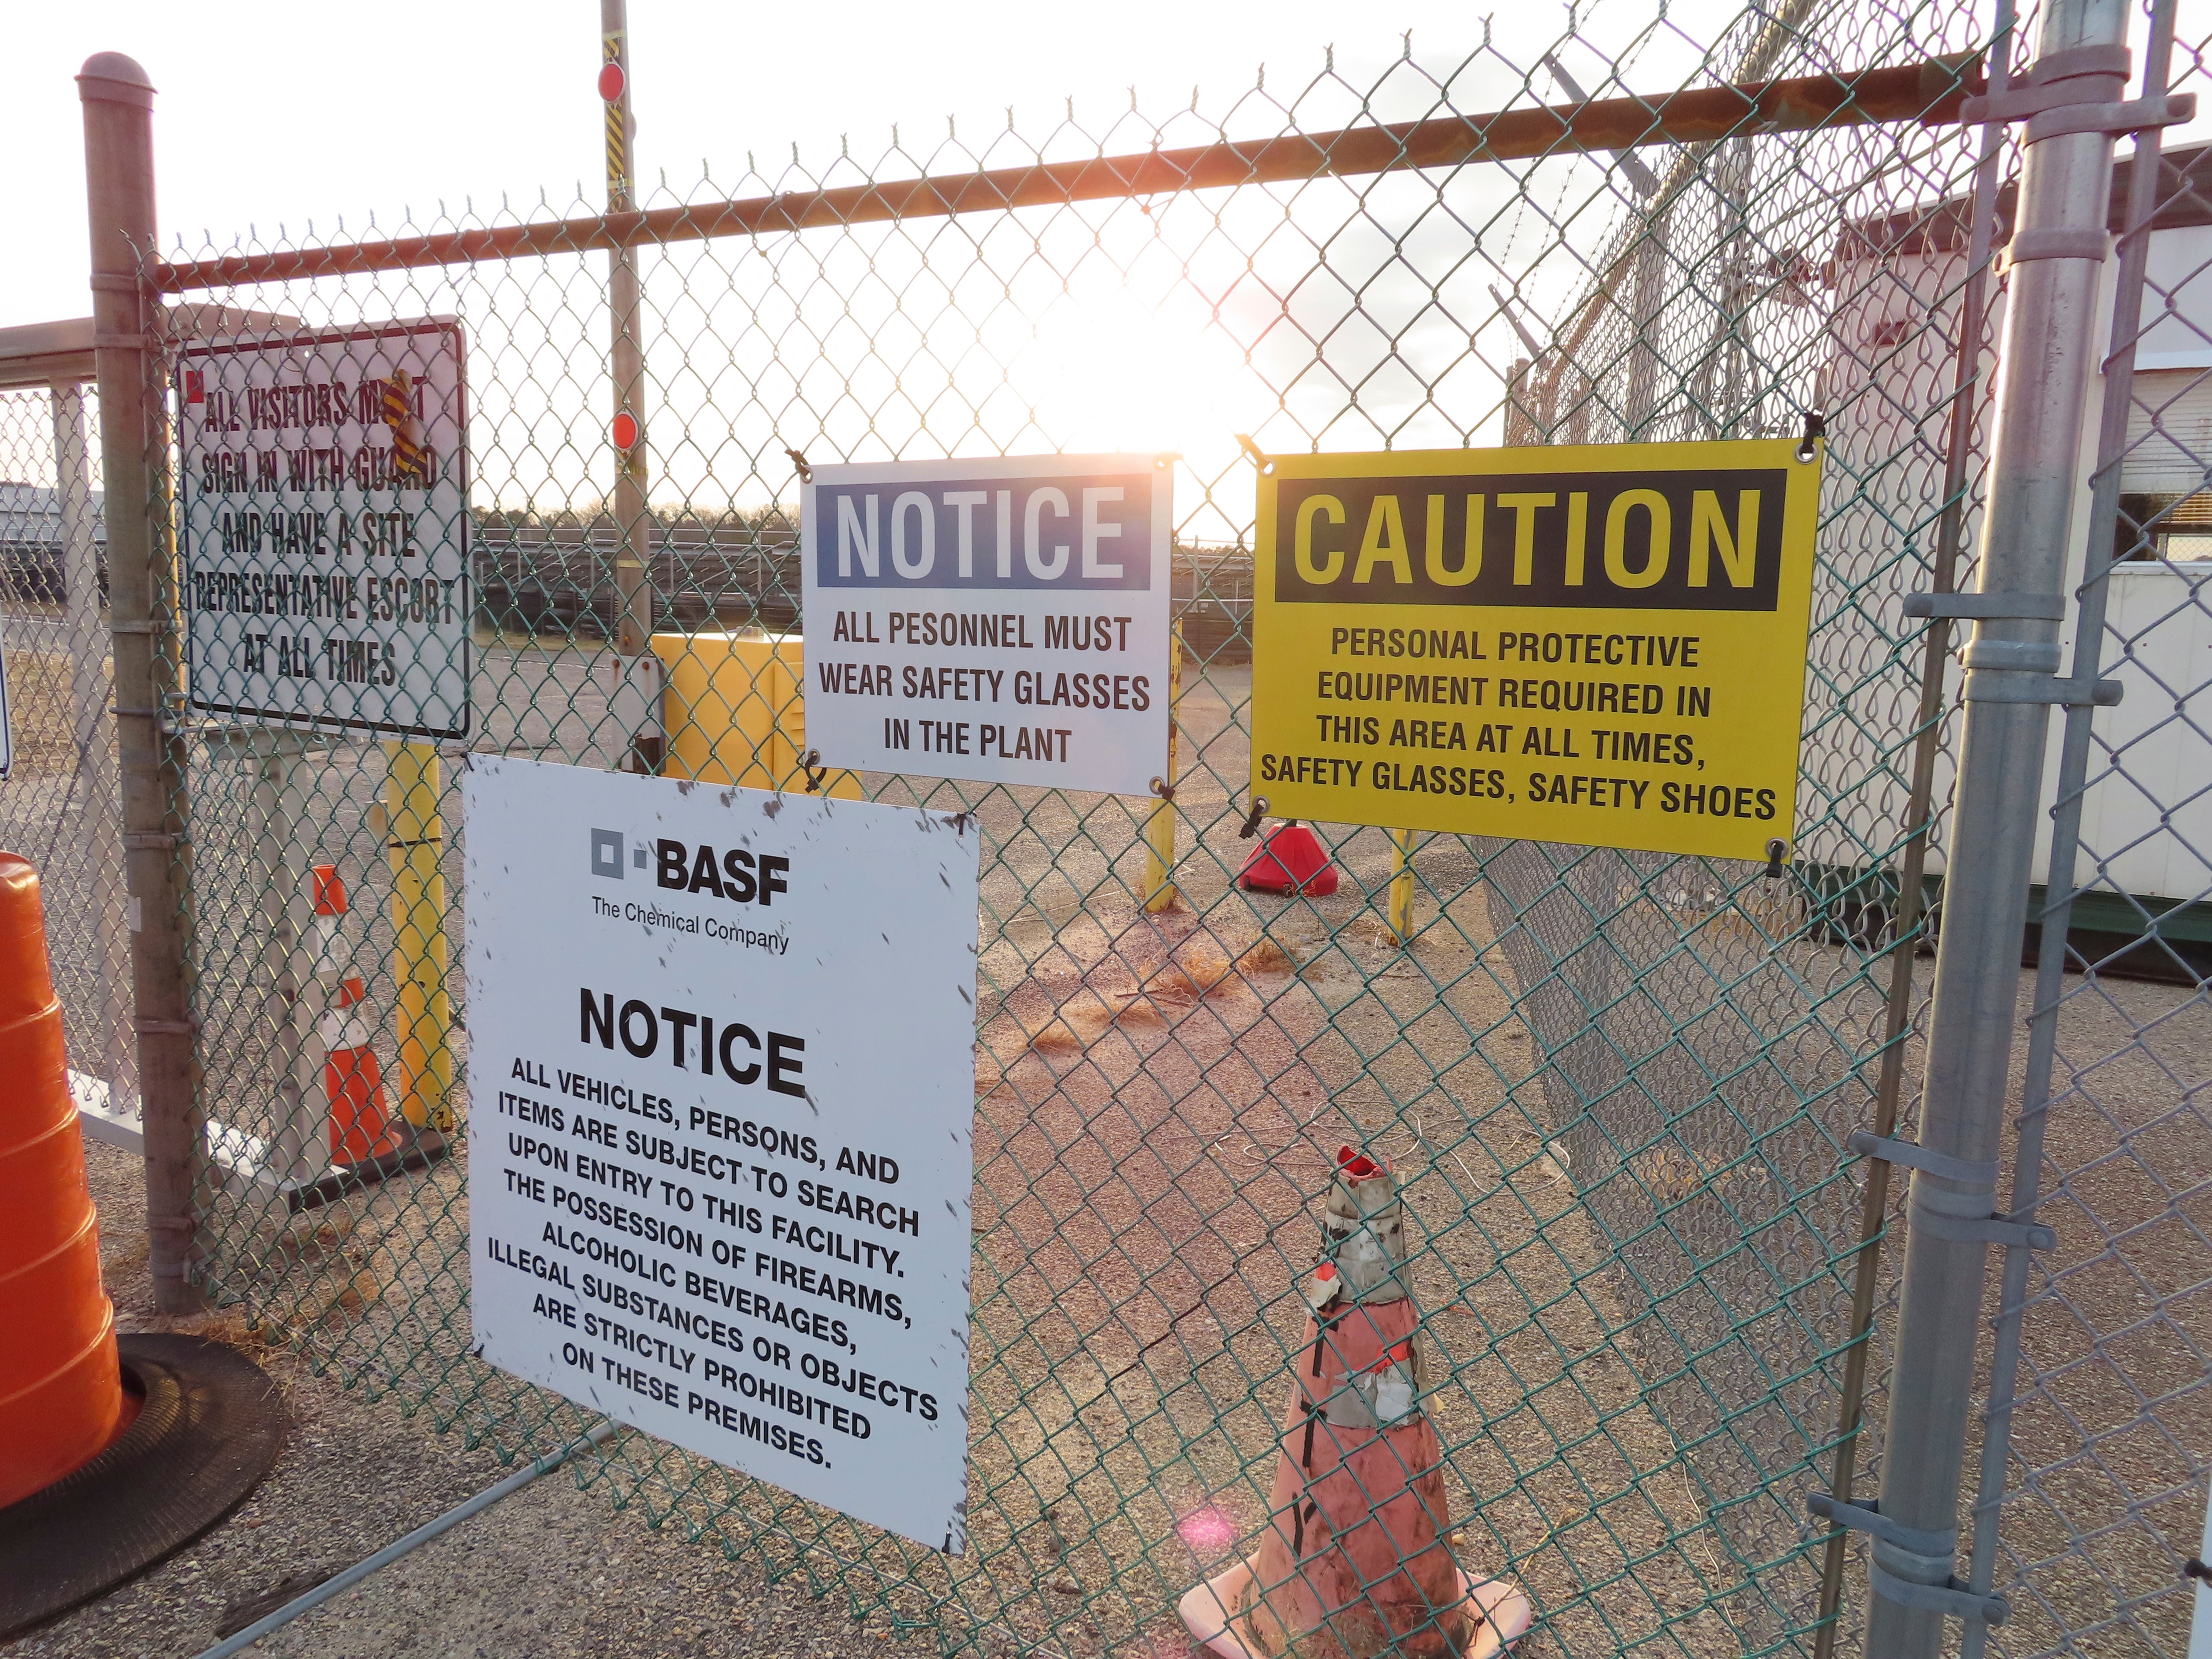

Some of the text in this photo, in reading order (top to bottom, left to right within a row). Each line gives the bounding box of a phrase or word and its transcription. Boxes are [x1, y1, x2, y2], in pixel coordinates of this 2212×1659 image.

[205, 376, 427, 432] ALL VISITORS MT
[202, 451, 247, 494] SIGN
[257, 450, 277, 492] IN
[286, 448, 344, 492] WITH
[222, 512, 415, 557] AND HAVE A SITE
[837, 486, 1124, 580] NOTICE
[1294, 489, 1761, 589] CAUTION
[195, 571, 454, 624] REPRESENTATIVE ESCORT
[244, 633, 396, 686] AT ALL TIMES
[833, 611, 1132, 651] ALL PESONNEL MUST
[1332, 627, 1700, 667] PERSONAL PROTECTIVE
[818, 662, 1150, 711] WEAR SAFETY GLASSES
[1318, 671, 1711, 717] EQUIPMENT REQUIRED IN
[885, 717, 1072, 763] IN THE PLANT
[1316, 714, 1705, 771] THIS AREA AT ALL TIMES,
[1261, 754, 1776, 820] SAFETY GLASSES, SAFETY SHOES
[657, 838, 789, 906] BASF
[592, 896, 789, 955] The Chemical Company
[580, 987, 805, 1099] NOTICE
[512, 1057, 899, 1184] ALL VEHICLES, PERSONS, AND
[499, 1091, 919, 1237] ITEMS ARE SUBJECT TO SEARCH
[509, 1132, 904, 1278] UPON ENTRY TO THIS FACILITY.
[504, 1168, 911, 1330] THE POSSESSION OF FIREARMS,
[542, 1221, 856, 1356] ALCOHOLIC BEVERAGES,
[488, 1237, 938, 1421] ILLEGAL SUBSTANCES OR OBJECTS
[533, 1293, 870, 1439] ARE STRICTLY PROHIBITED
[563, 1342, 831, 1469] ON THESE PREMISES.
